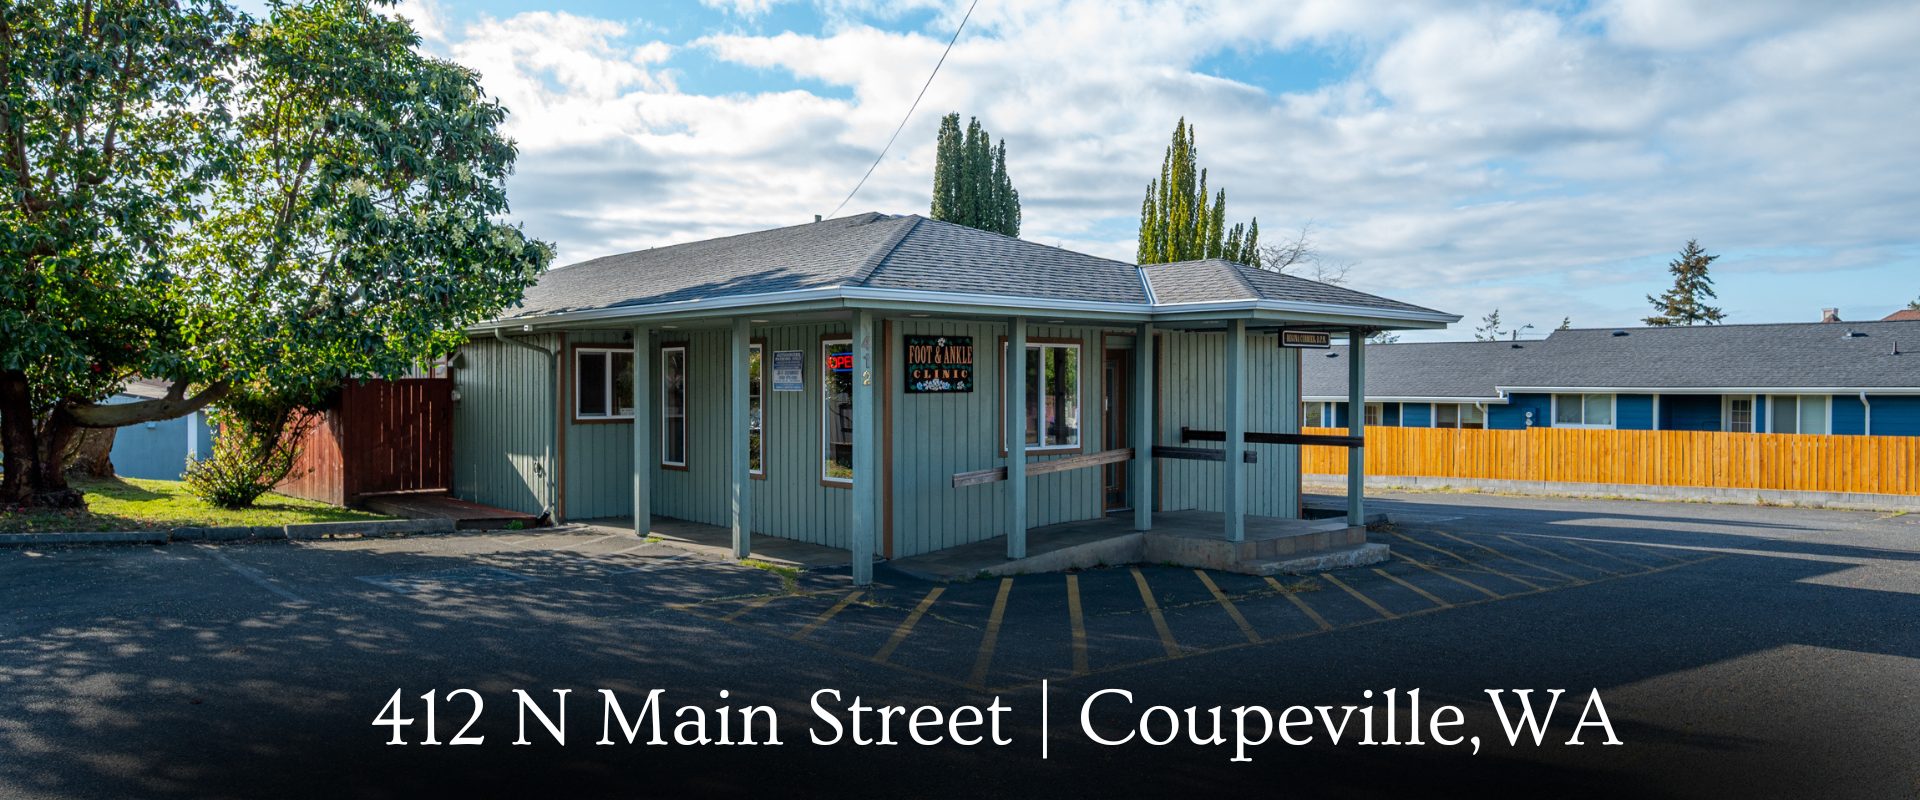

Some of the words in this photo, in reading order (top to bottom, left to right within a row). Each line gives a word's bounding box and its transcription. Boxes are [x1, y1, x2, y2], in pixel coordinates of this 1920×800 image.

[908, 345, 933, 364] FOOT
[934, 346, 942, 364] &
[943, 345, 973, 364] ANKLE
[830, 356, 854, 369] OPE
[913, 369, 968, 379] CLINIC
